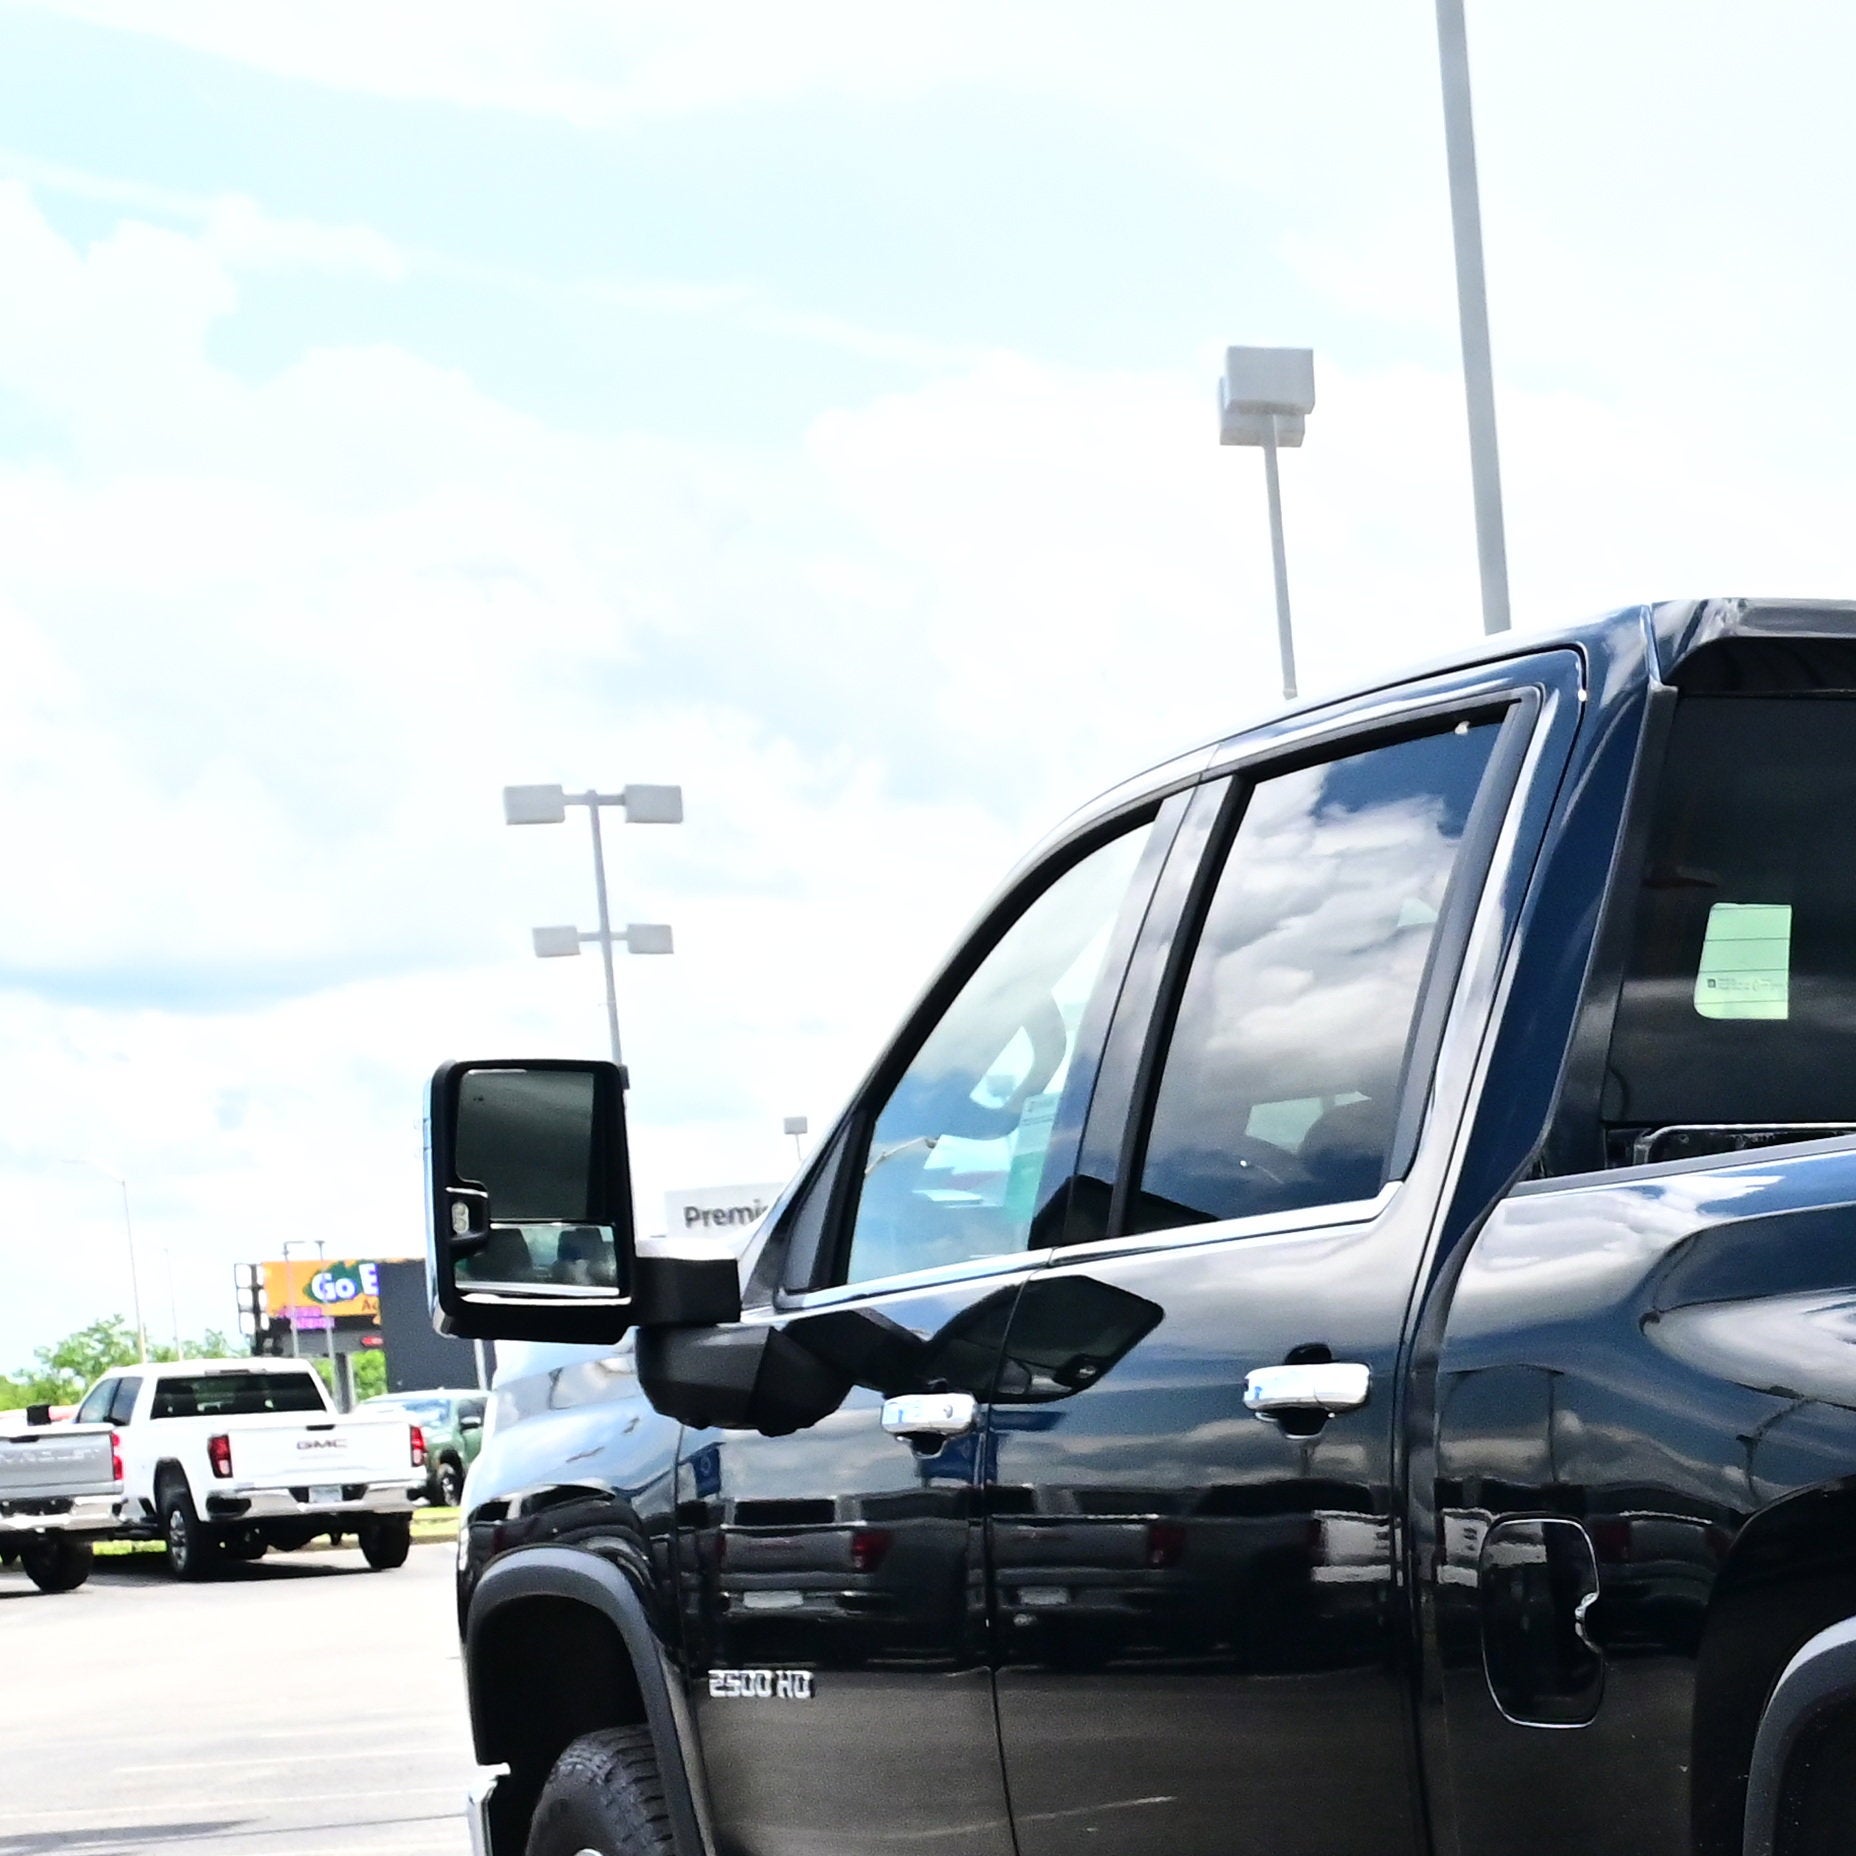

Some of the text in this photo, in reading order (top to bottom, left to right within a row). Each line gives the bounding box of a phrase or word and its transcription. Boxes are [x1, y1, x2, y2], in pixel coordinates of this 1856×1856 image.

[311, 1272, 356, 1301] Go
[296, 1438, 349, 1451] GMC
[708, 1669, 774, 1698] 2500
